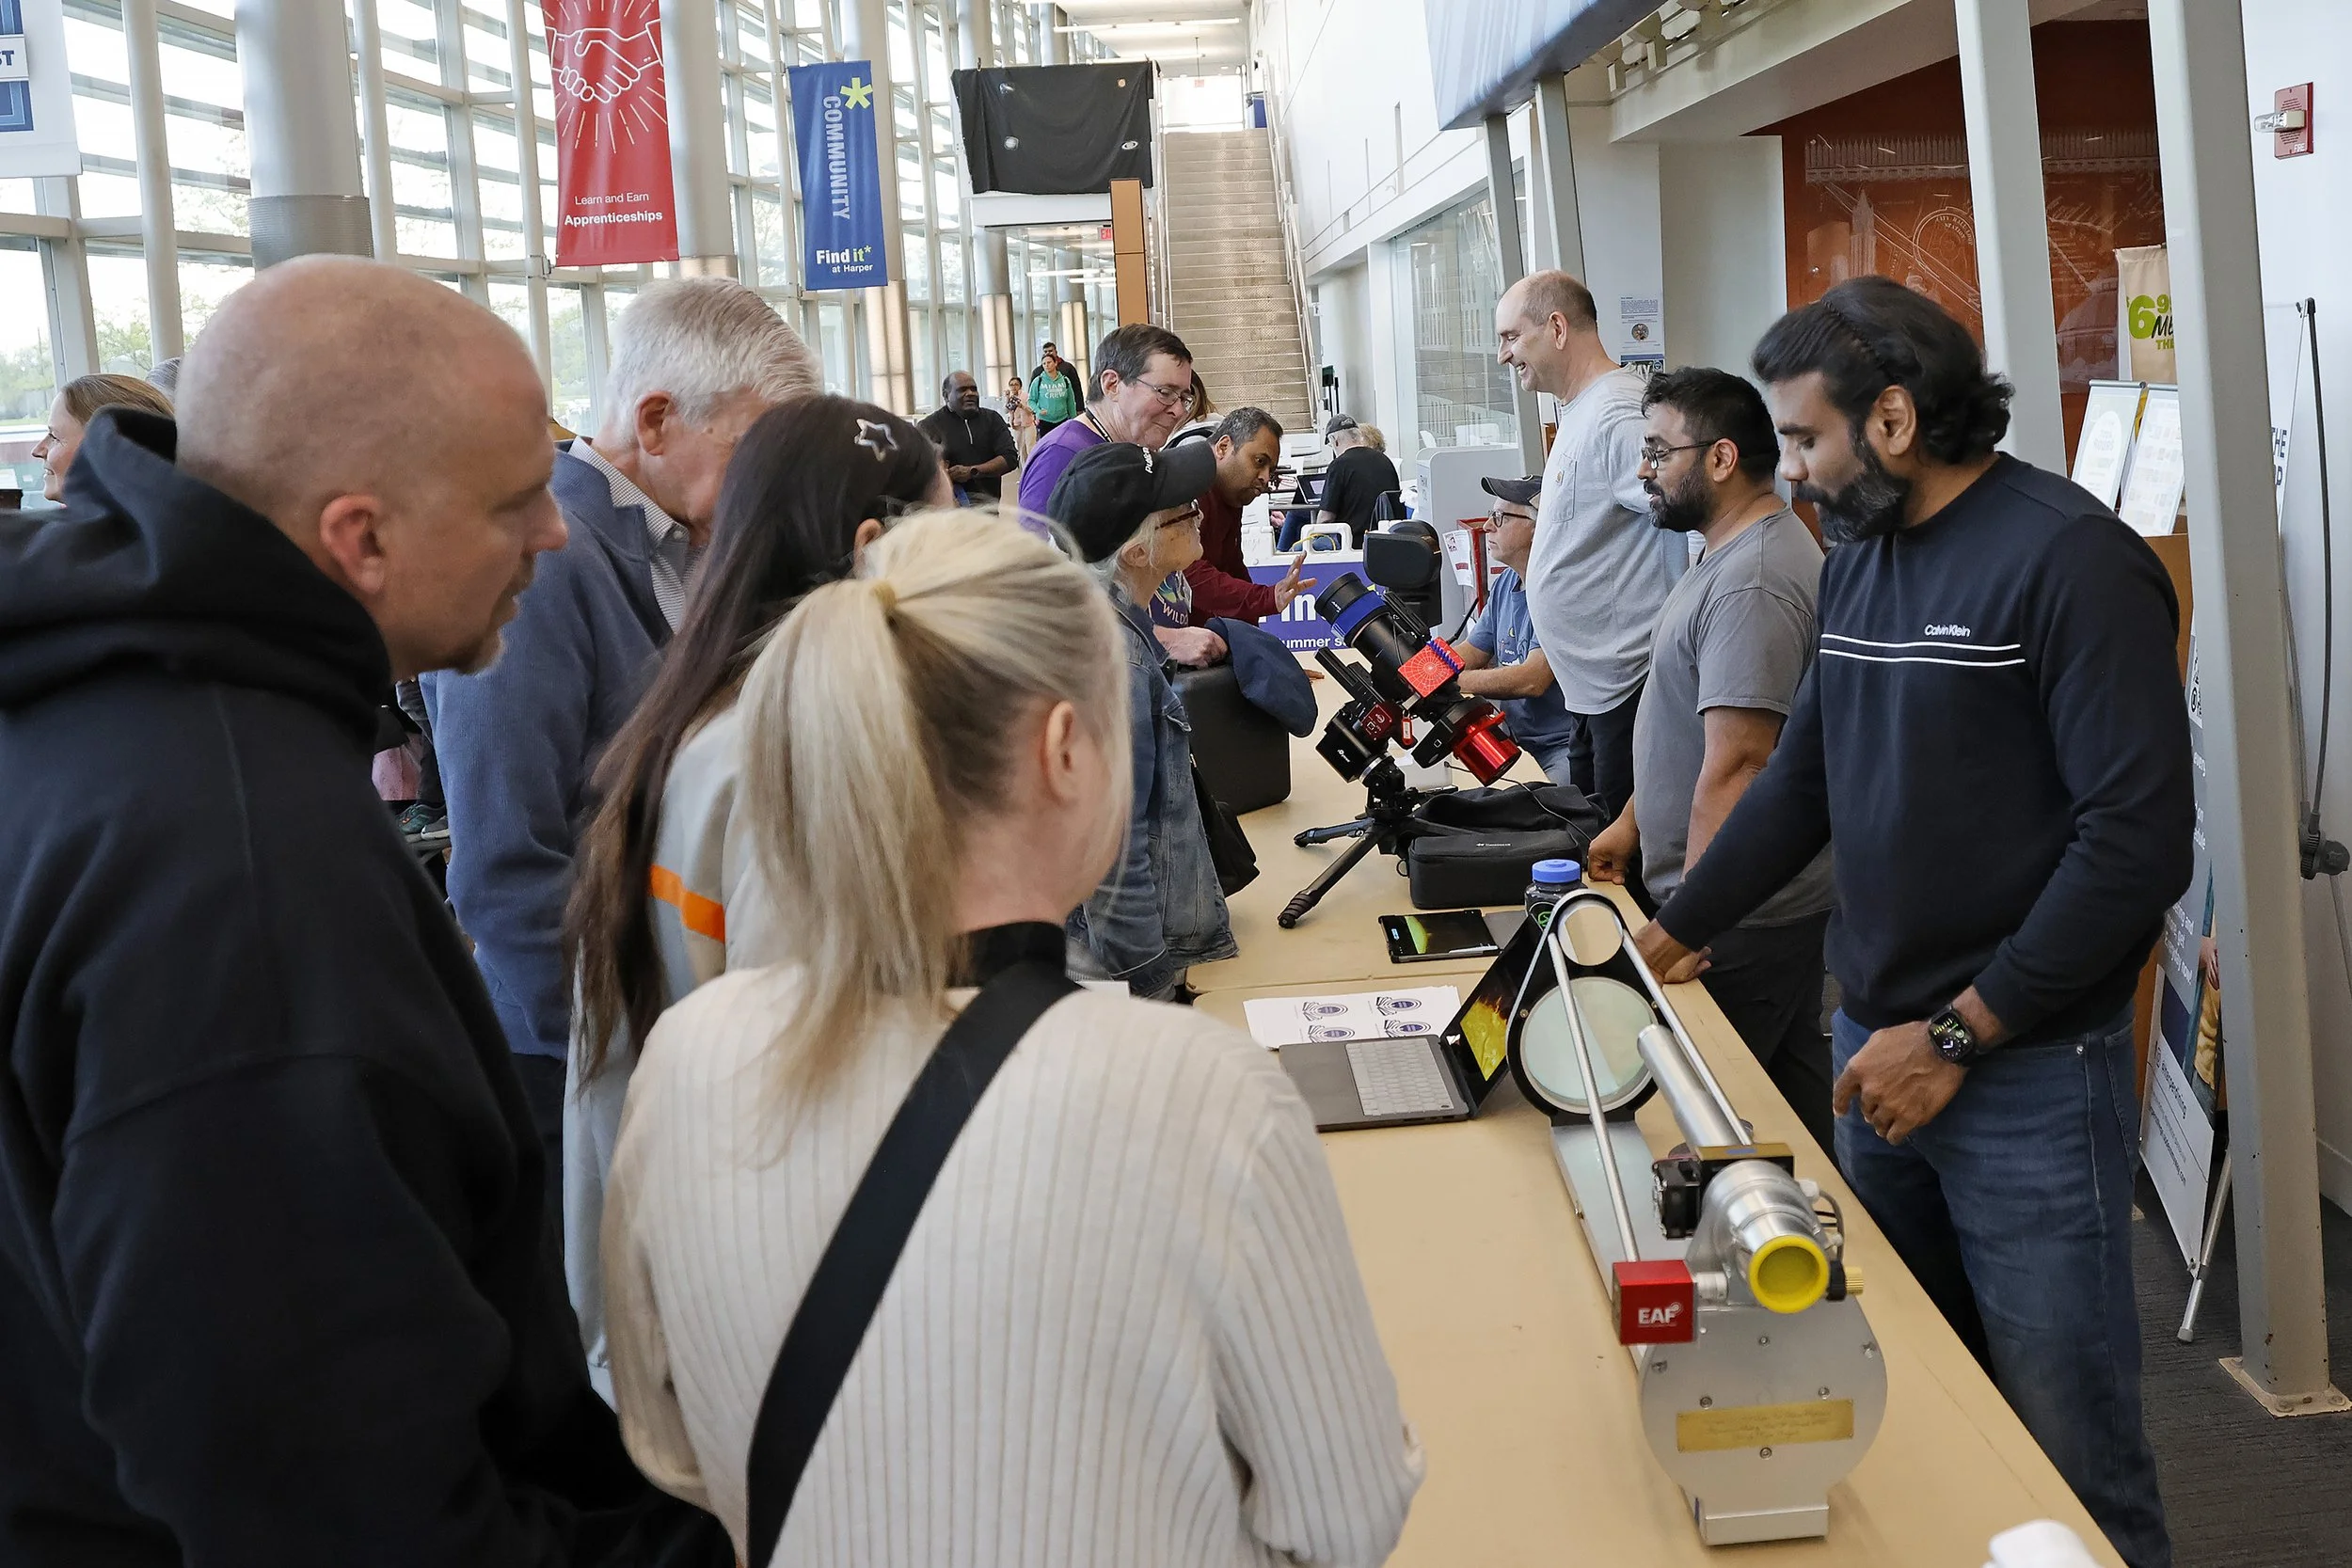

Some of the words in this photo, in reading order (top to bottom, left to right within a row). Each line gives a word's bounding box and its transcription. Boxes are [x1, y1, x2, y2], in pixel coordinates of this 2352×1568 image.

[0, 50, 14, 66] T
[2294, 142, 2305, 152] FIRE
[823, 96, 850, 219] COMMUNITY
[574, 196, 602, 205] Learn
[605, 193, 623, 203] and
[627, 192, 649, 202] Earn
[564, 211, 663, 227] Apprenticeships
[816, 248, 850, 264] Find
[832, 265, 841, 274] at
[843, 264, 873, 273] Harper
[1281, 638, 1331, 649] ummer
[1638, 1307, 1676, 1324] EAF
